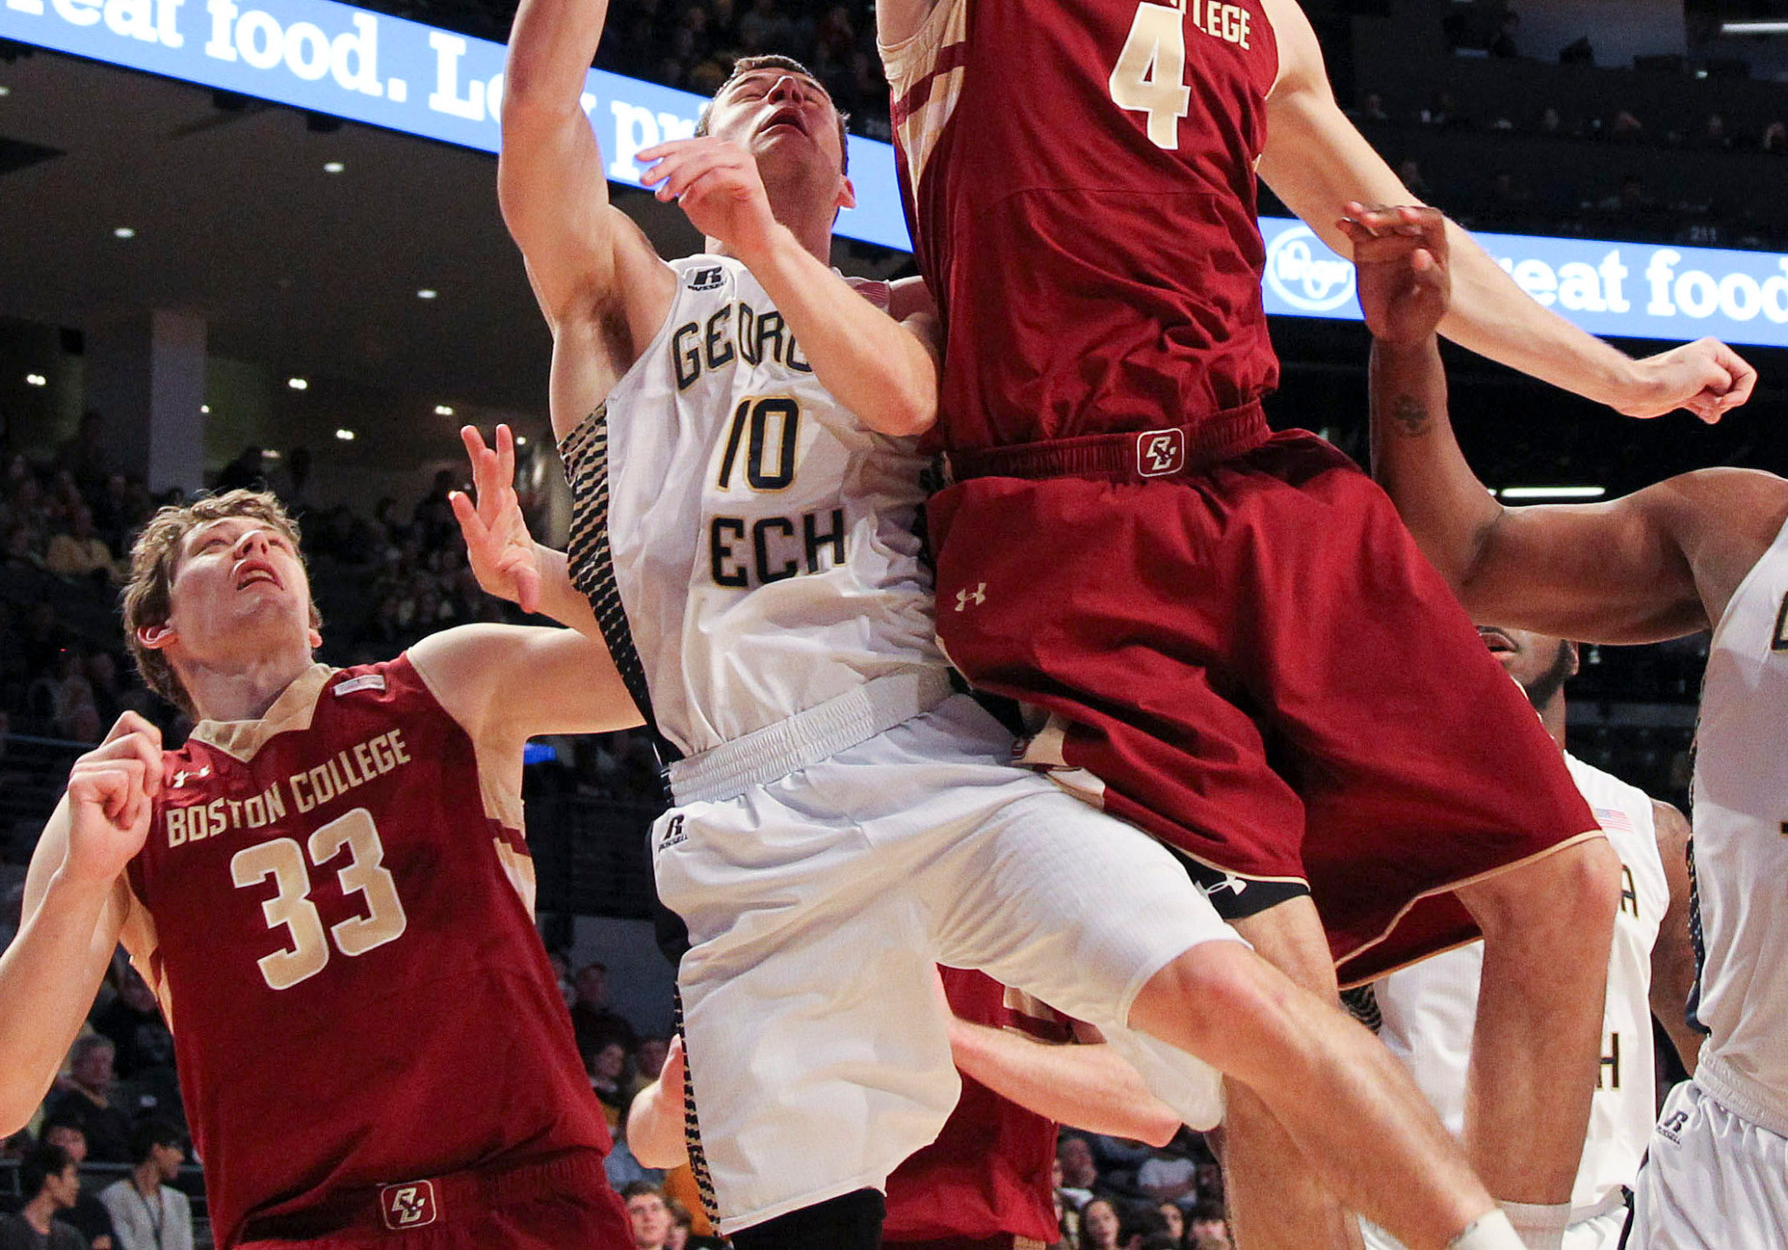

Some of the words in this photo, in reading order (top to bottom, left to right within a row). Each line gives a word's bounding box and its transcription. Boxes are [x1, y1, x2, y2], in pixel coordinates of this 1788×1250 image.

[1108, 1, 1192, 151] 4
[717, 395, 801, 495] 10
[166, 780, 287, 849] BOSTON
[289, 728, 412, 815] COLLEGE
[230, 806, 408, 991] 33
